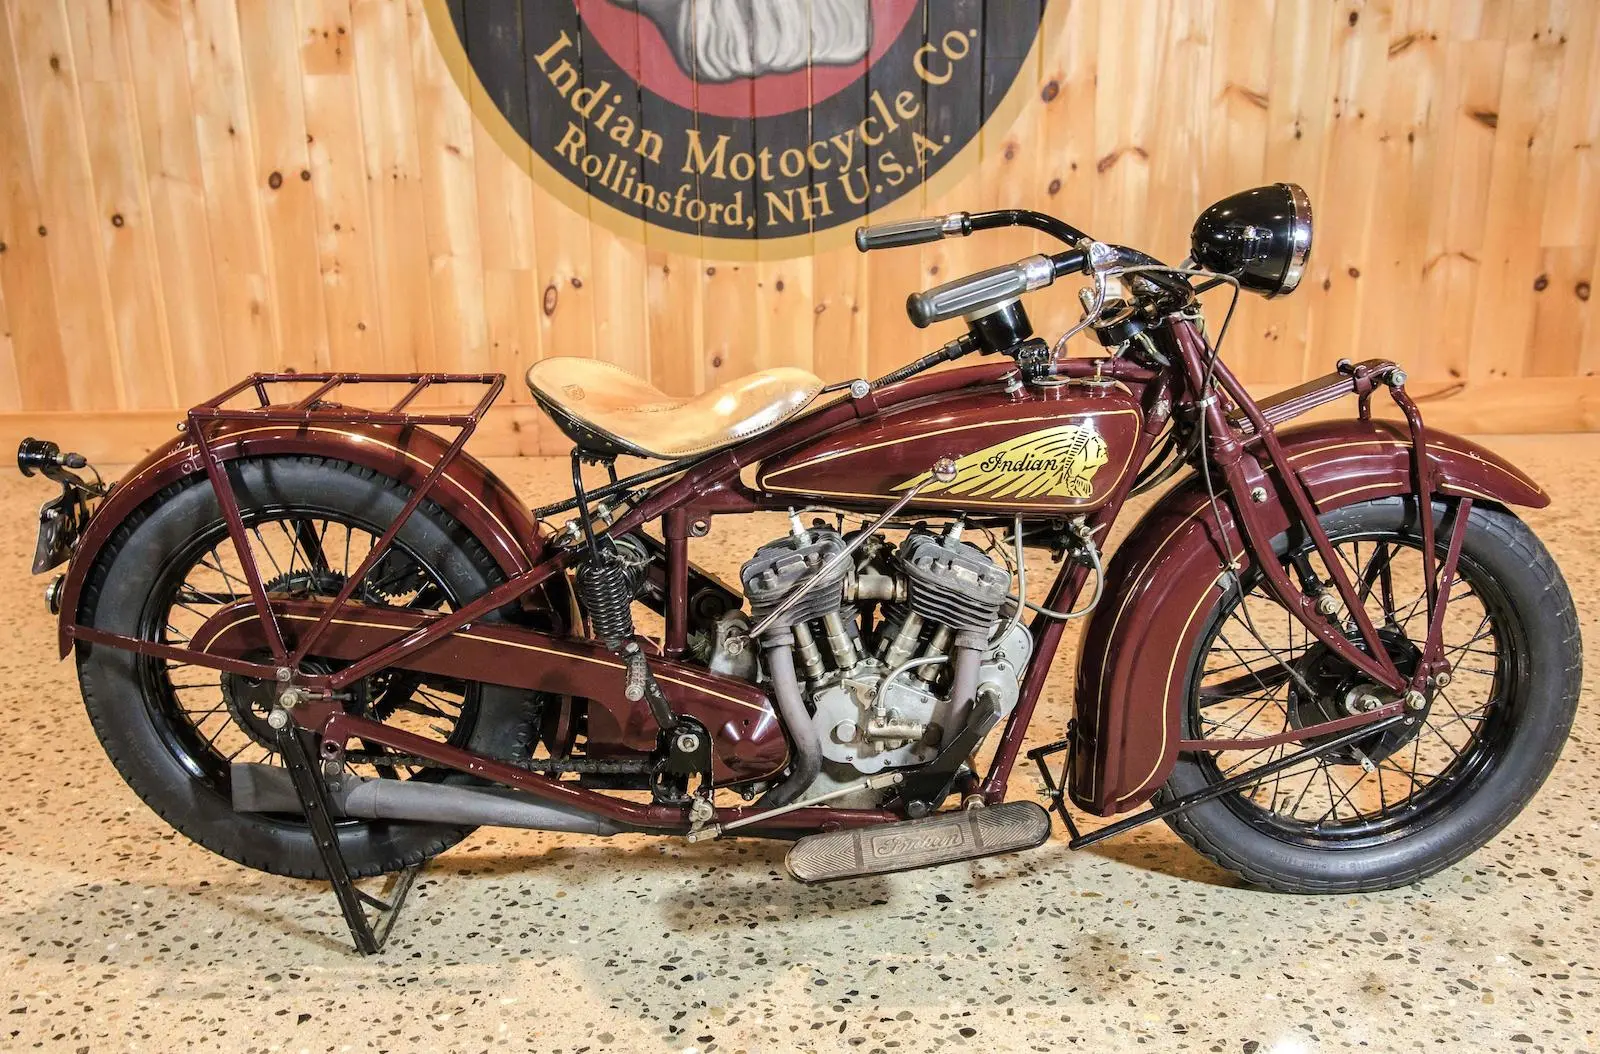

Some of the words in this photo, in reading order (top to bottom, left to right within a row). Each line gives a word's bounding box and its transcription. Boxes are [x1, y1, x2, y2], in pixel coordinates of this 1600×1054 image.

[533, 30, 665, 164] Indian
[681, 88, 922, 181] Motocycle
[913, 27, 979, 86] Co.
[554, 121, 757, 231] Rollinsford,
[764, 182, 834, 227] NH
[838, 130, 952, 205] U.S.A.
[980, 451, 1059, 474] Indian
[877, 832, 960, 855] Indian
